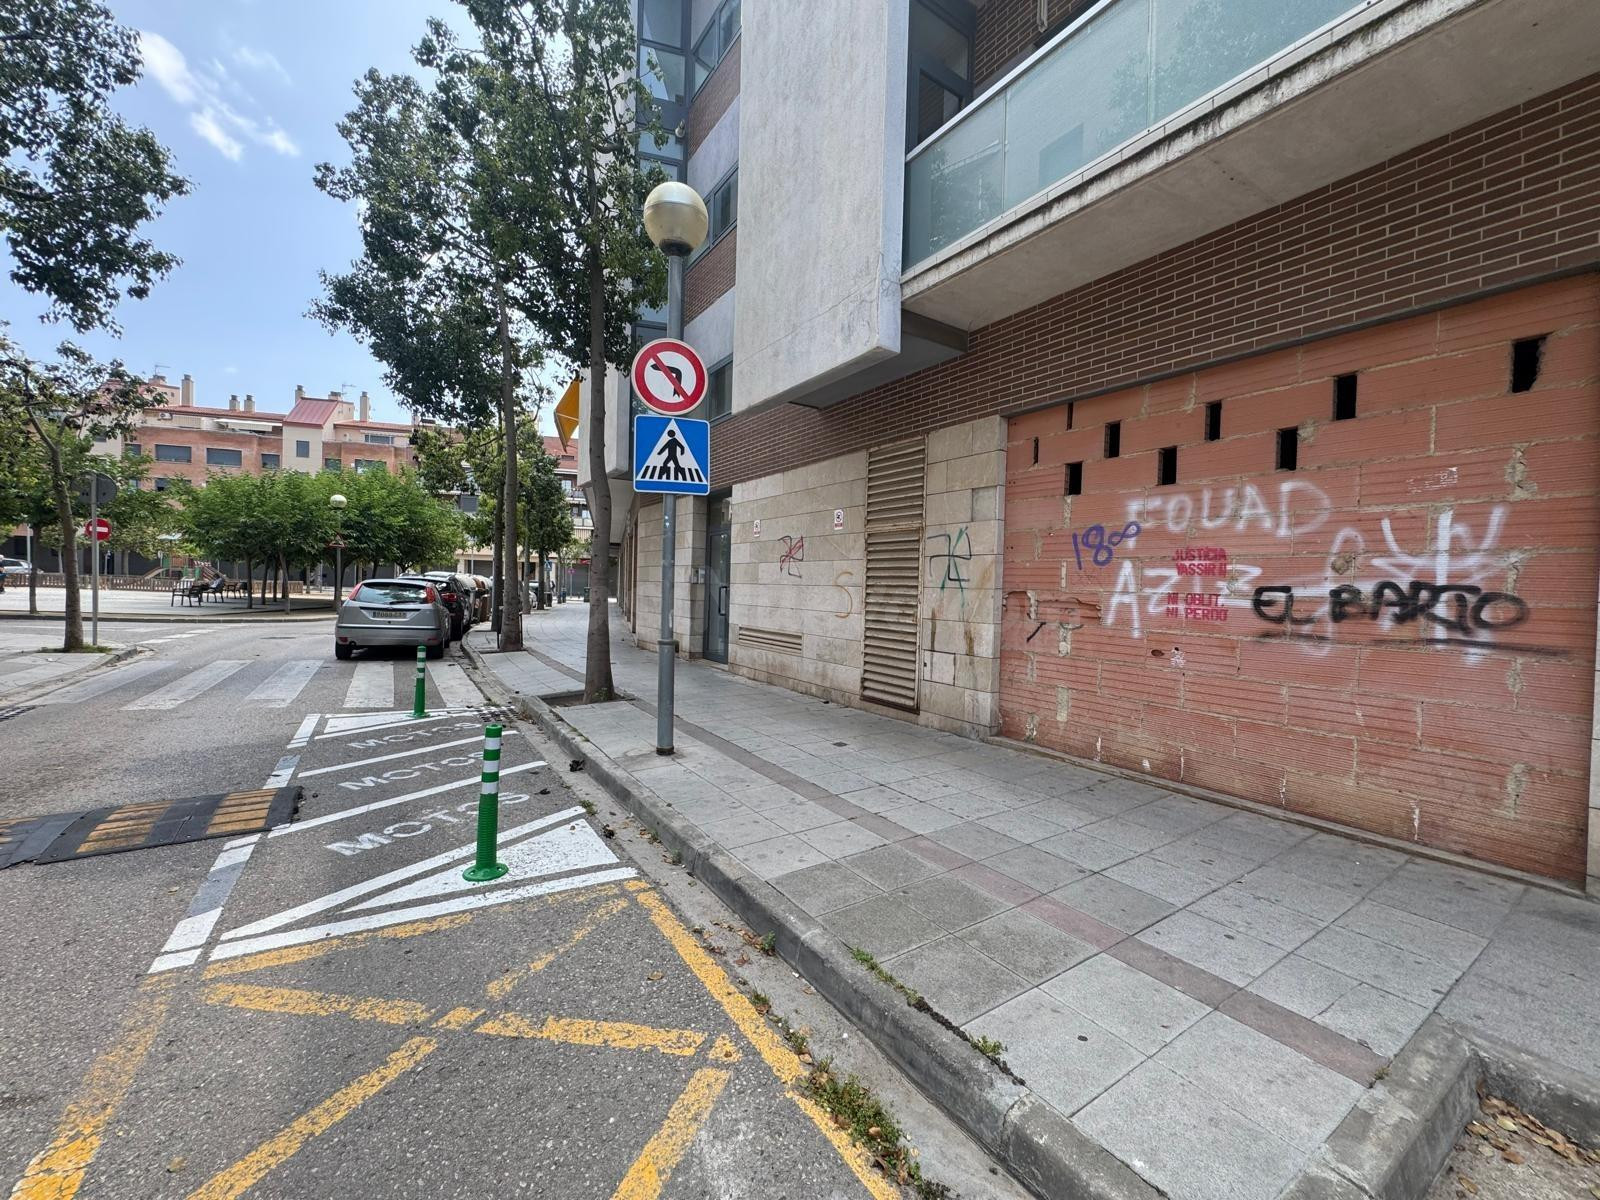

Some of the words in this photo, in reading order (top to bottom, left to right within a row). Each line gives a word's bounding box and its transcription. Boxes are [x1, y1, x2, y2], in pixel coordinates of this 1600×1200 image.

[1125, 479, 1332, 550] FOUAD
[1167, 592, 1179, 605] NI
[1252, 585, 1317, 626] EL
[1328, 580, 1531, 636] BARTO
[1166, 606, 1179, 619] NI
[346, 722, 483, 749] MOTOS
